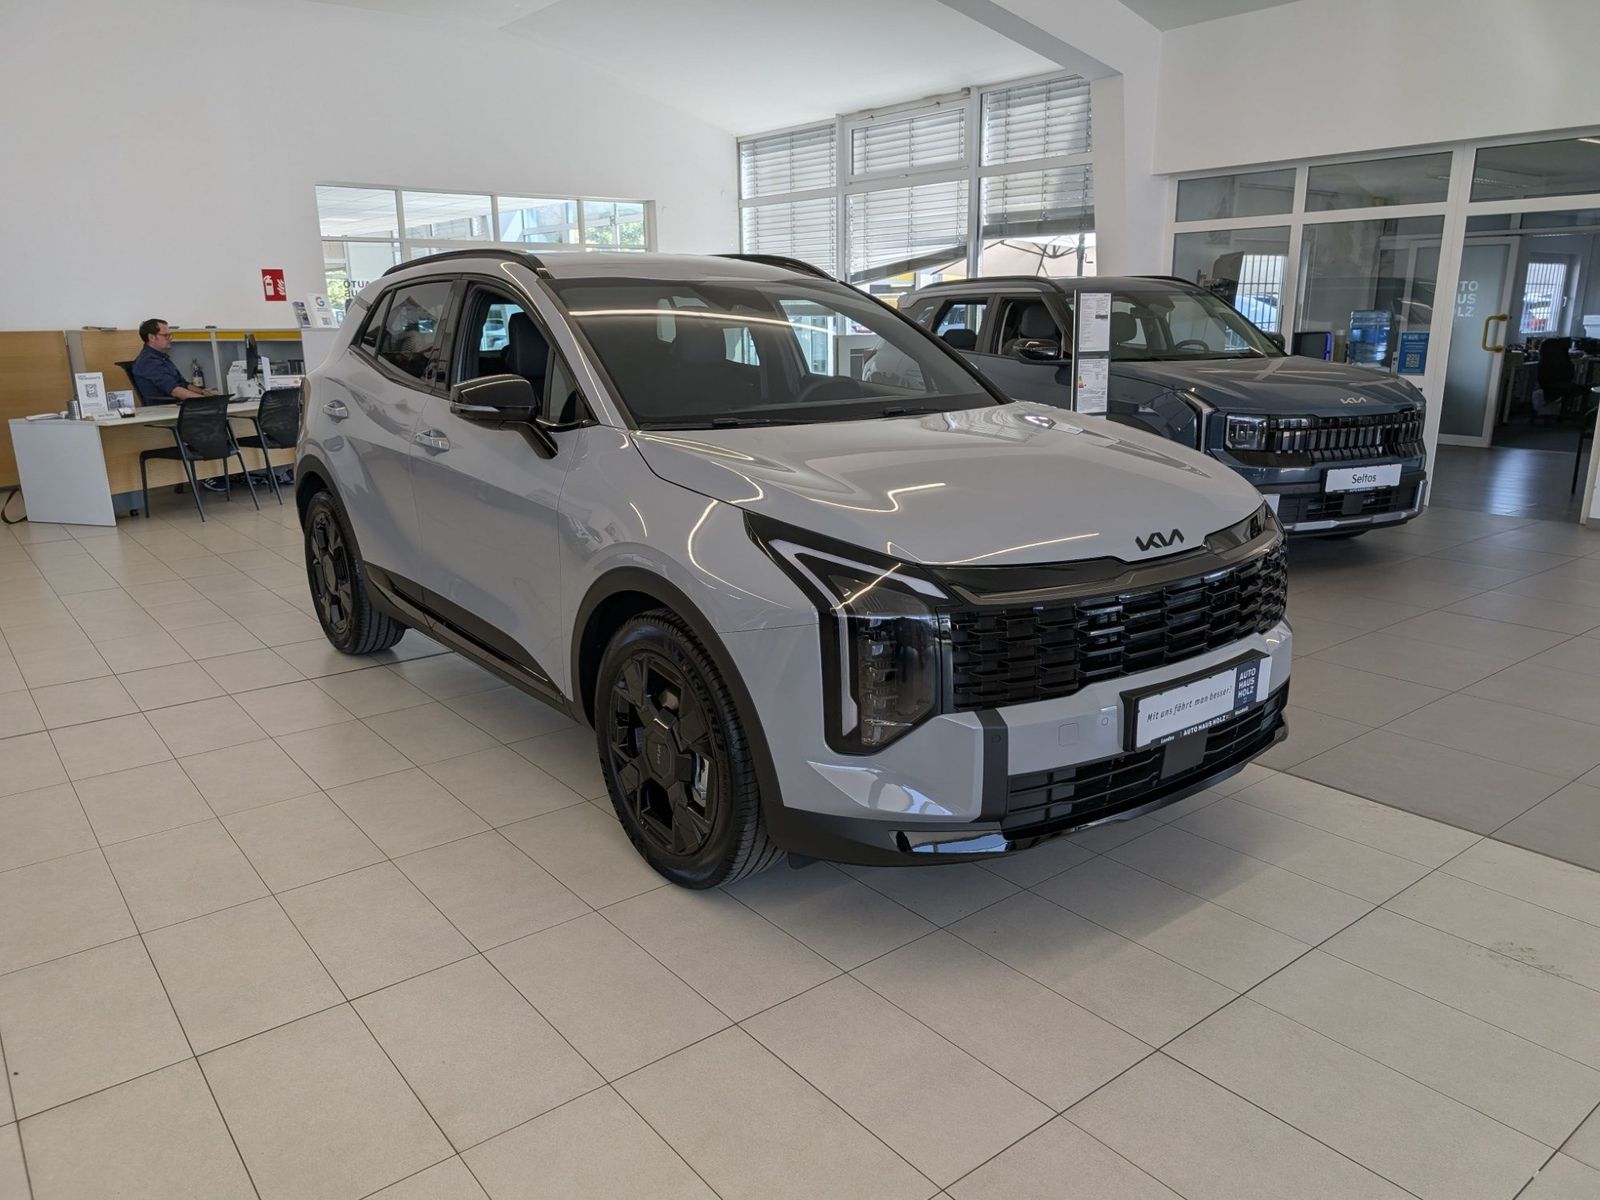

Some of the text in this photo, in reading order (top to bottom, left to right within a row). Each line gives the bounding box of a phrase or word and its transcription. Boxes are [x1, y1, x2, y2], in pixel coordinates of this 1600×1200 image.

[1460, 280, 1479, 291] TO
[1457, 293, 1477, 304] US
[1457, 306, 1474, 317] LZ
[1351, 473, 1377, 485] Seltos
[1135, 528, 1184, 551] KIA
[1239, 668, 1256, 680] AUTO
[1238, 677, 1255, 690] HAUS
[1237, 686, 1254, 699] HOLZ
[1147, 711, 1160, 722] Mit
[1160, 707, 1173, 719] uns
[1173, 700, 1192, 715] fährt
[1194, 695, 1209, 706] man
[1183, 726, 1198, 737] AUTO
[1198, 720, 1213, 730] HAUS
[1212, 714, 1227, 724] HOLZ
